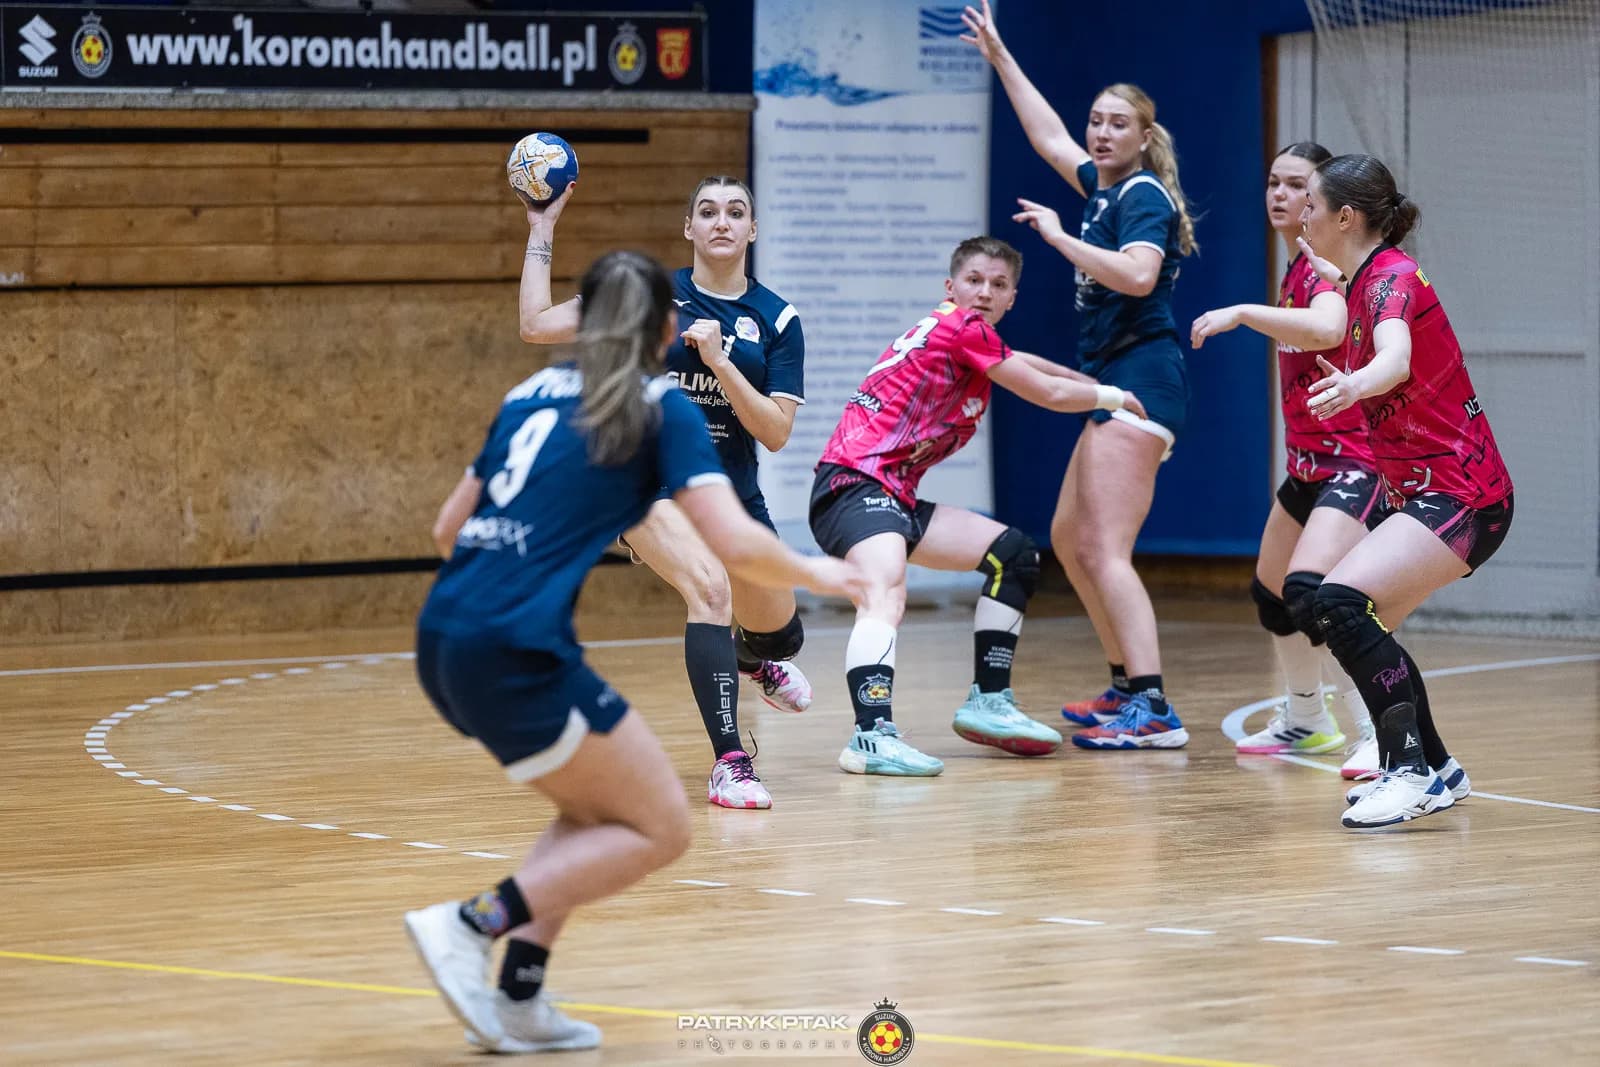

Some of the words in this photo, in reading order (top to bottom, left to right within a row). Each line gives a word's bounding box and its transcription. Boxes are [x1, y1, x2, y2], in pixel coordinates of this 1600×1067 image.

[18, 65, 58, 78] SUZUKI
[126, 19, 597, 86] www.koronahandball.pl
[488, 407, 559, 508] 9
[863, 496, 890, 508] Targi
[713, 672, 736, 735] kalenji
